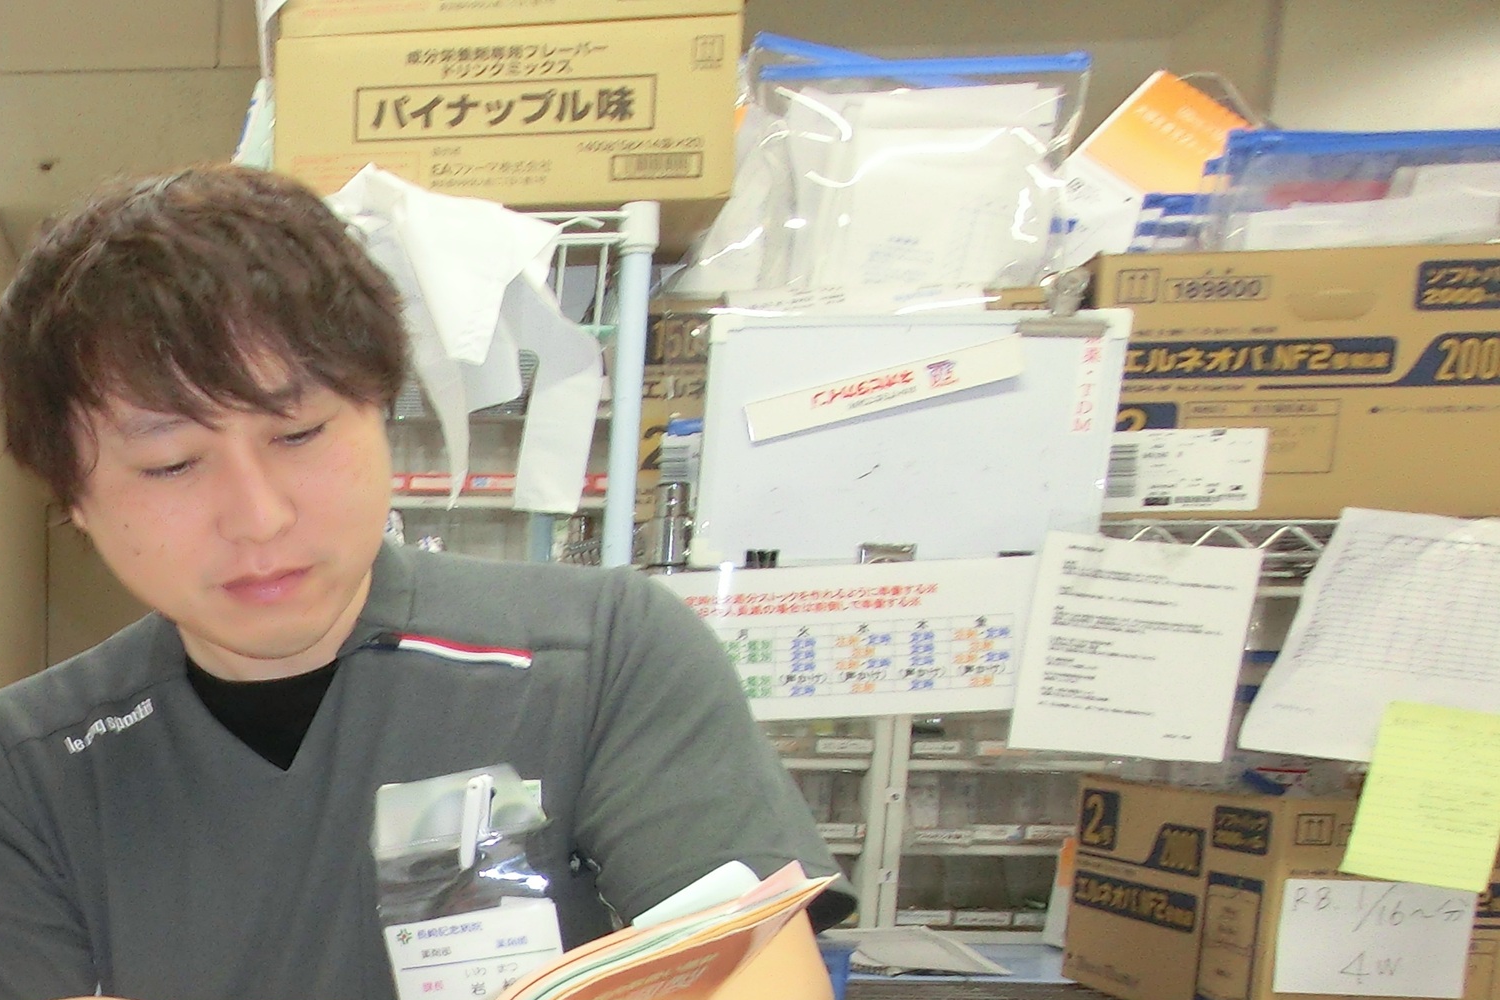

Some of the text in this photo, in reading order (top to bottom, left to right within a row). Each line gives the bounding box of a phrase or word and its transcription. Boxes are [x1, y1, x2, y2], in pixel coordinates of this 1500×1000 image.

[371, 85, 637, 129] パイナップル味
[471, 981, 487, 997] 岩
